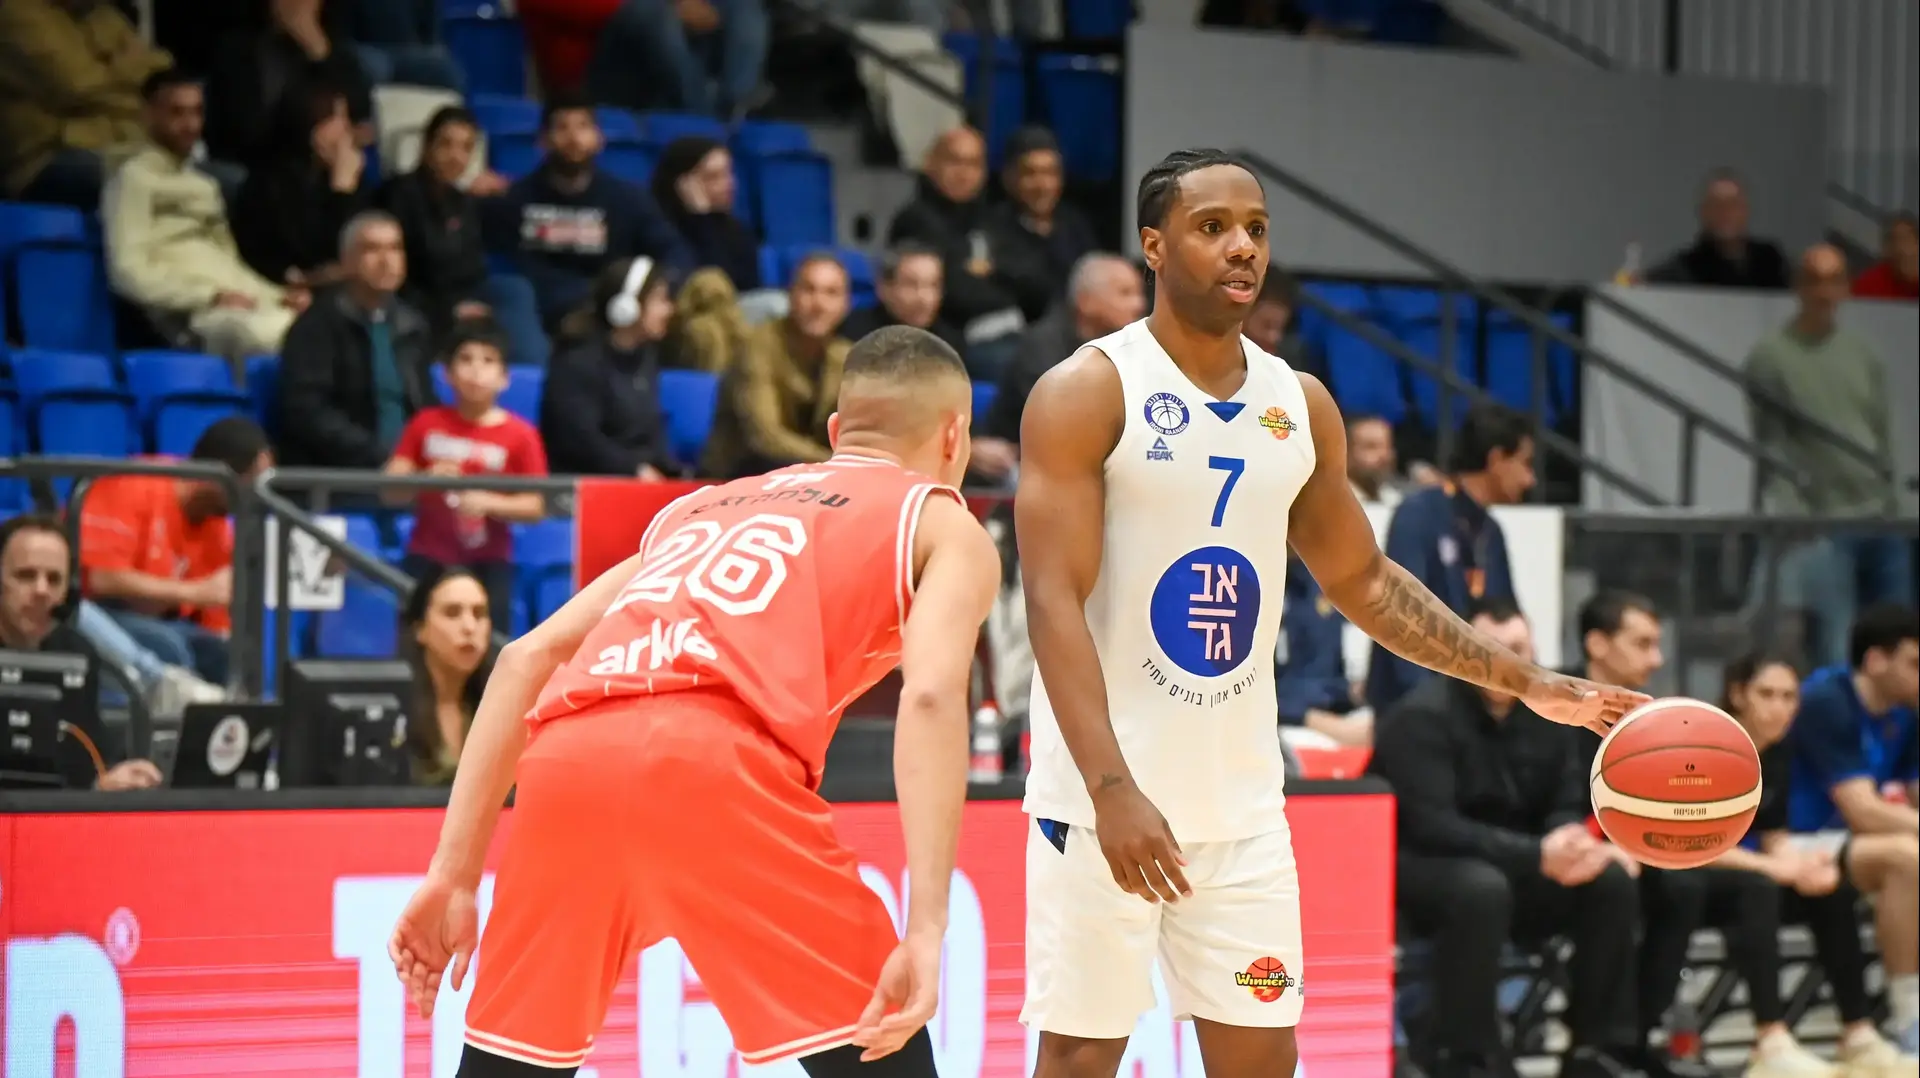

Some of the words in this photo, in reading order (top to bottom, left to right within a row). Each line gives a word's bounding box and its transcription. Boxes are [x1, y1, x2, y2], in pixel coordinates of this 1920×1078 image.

[1258, 415, 1289, 430] Winner
[1146, 451, 1174, 462] PEAK
[1208, 455, 1245, 528] 7
[603, 513, 807, 616] 26
[1189, 562, 1238, 604] אב
[1187, 620, 1232, 661] גד
[1142, 658, 1167, 686] עתיד
[1169, 684, 1203, 706] בונים
[1235, 972, 1285, 987] Winner
